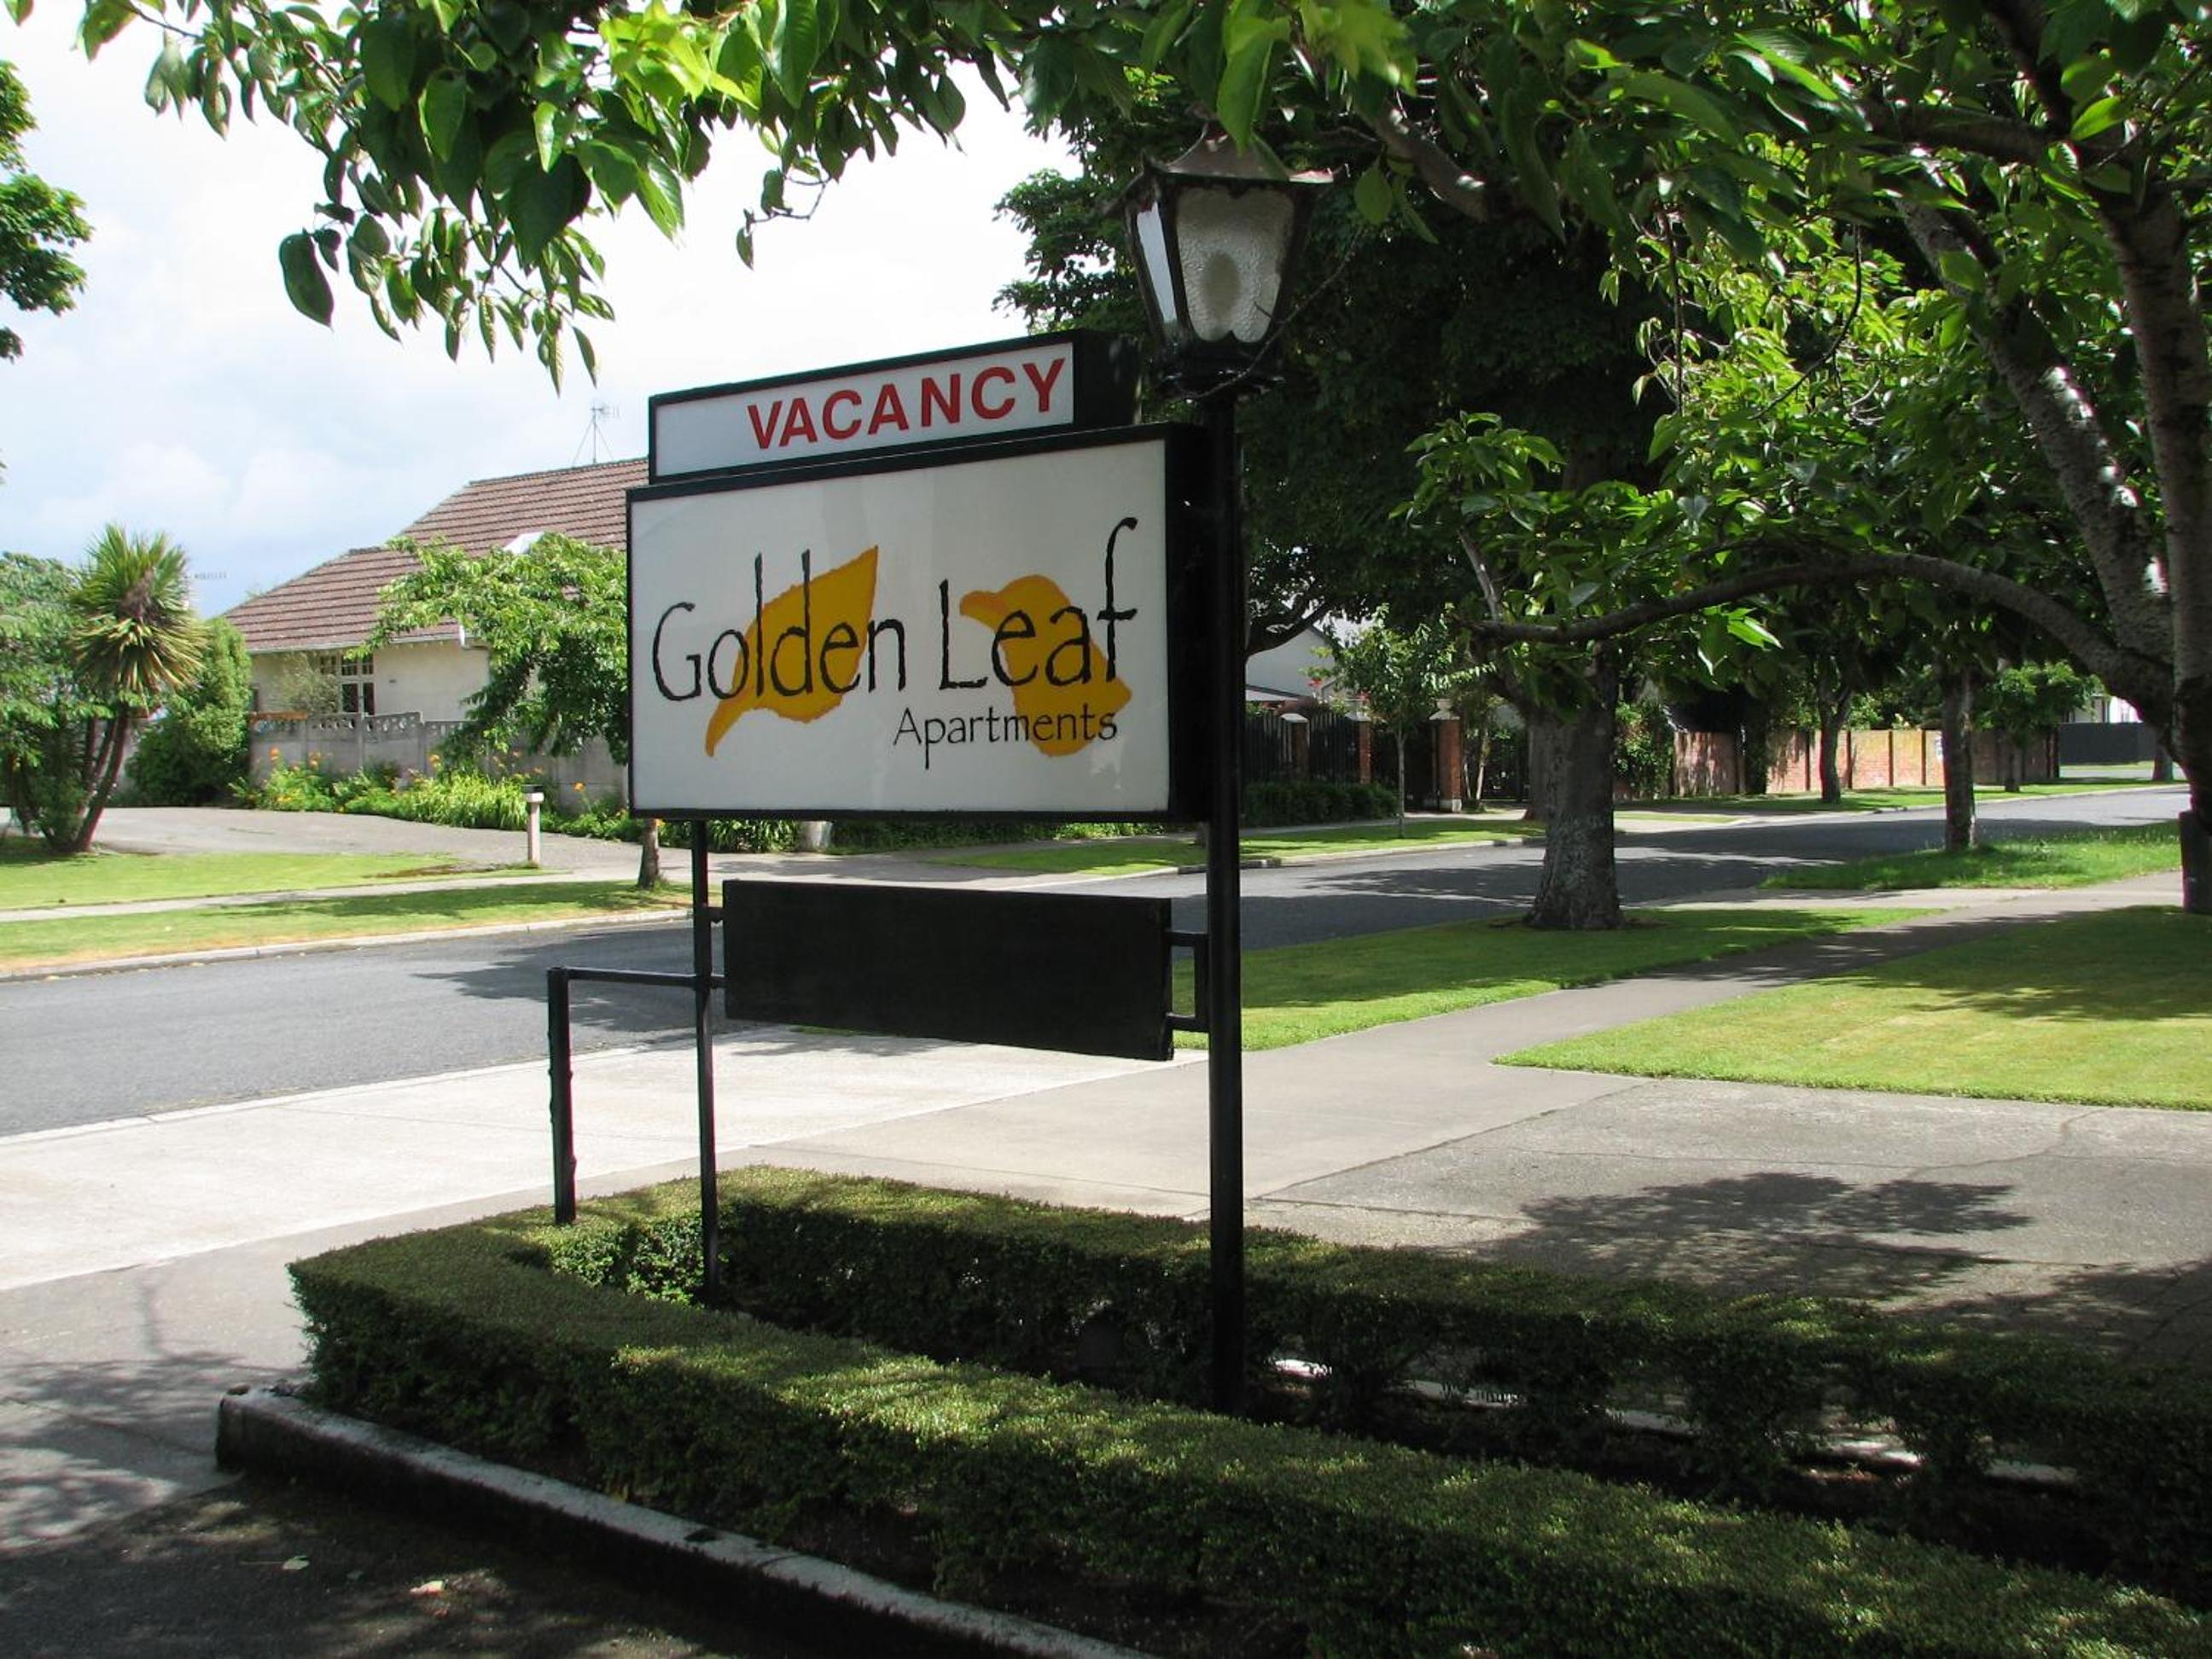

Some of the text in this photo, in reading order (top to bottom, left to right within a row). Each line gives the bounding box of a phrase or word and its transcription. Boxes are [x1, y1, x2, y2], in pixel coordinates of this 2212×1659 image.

[748, 358, 1065, 450] VACANCY
[653, 516, 1138, 701] Golden Leaf
[893, 703, 1118, 769] Apartments
